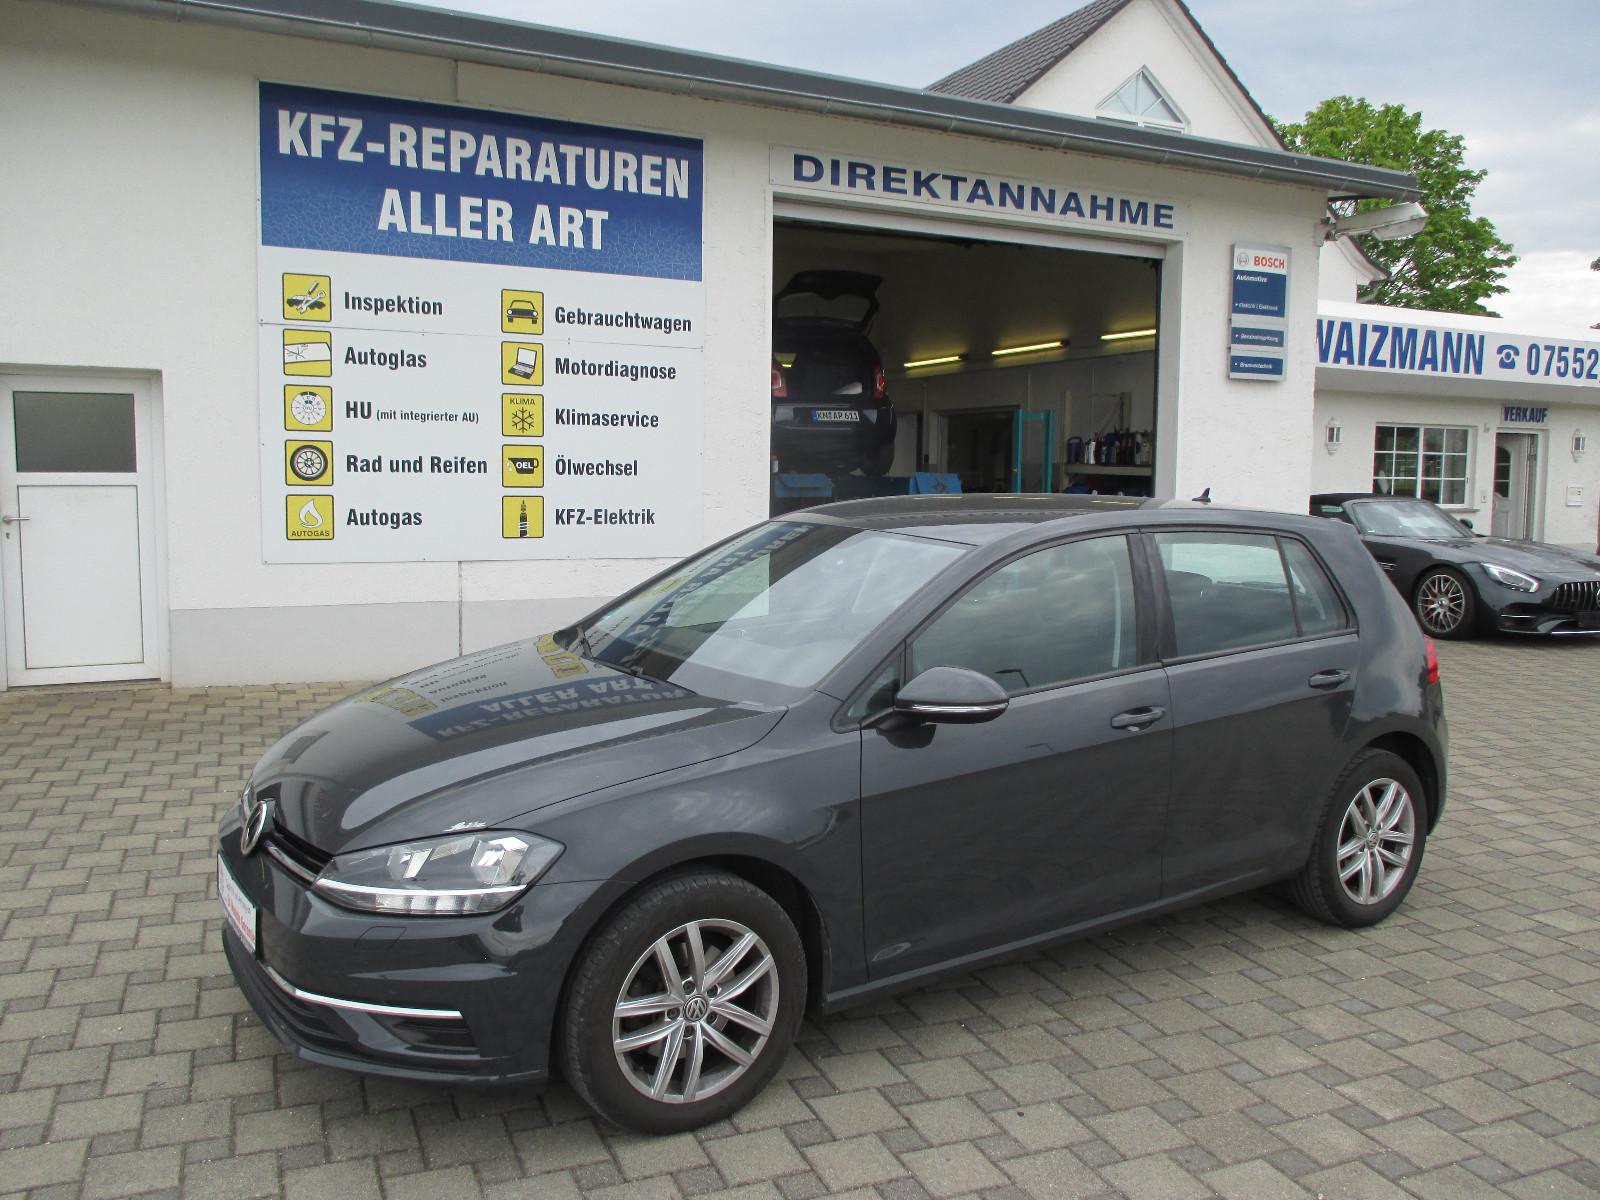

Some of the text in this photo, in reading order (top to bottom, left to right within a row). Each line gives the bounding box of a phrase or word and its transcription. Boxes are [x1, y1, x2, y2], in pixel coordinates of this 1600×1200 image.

[278, 109, 689, 199] KFZ-REPARATUREN
[793, 153, 1174, 229] DIREKTANNAHME
[377, 188, 609, 250] ALLER ART
[1254, 255, 1285, 269] BOSCH
[344, 291, 443, 316] Inspektion
[555, 307, 692, 334] Gebrauchtwagen
[344, 346, 427, 370] Autoglas
[555, 357, 677, 381] Motordiagnose
[1526, 343, 1599, 380] 07552
[345, 401, 479, 425] HU (mit integrierter AU)
[509, 397, 536, 406] KLIMA
[555, 407, 659, 428] Klimaservice
[1504, 406, 1548, 423] VERKAUF
[346, 455, 488, 475] Rad und Reifen
[515, 461, 534, 469] OEL
[555, 454, 638, 476] Ölwechsel
[346, 508, 423, 529] Autogas
[555, 508, 656, 525] KFZ-Elektrik
